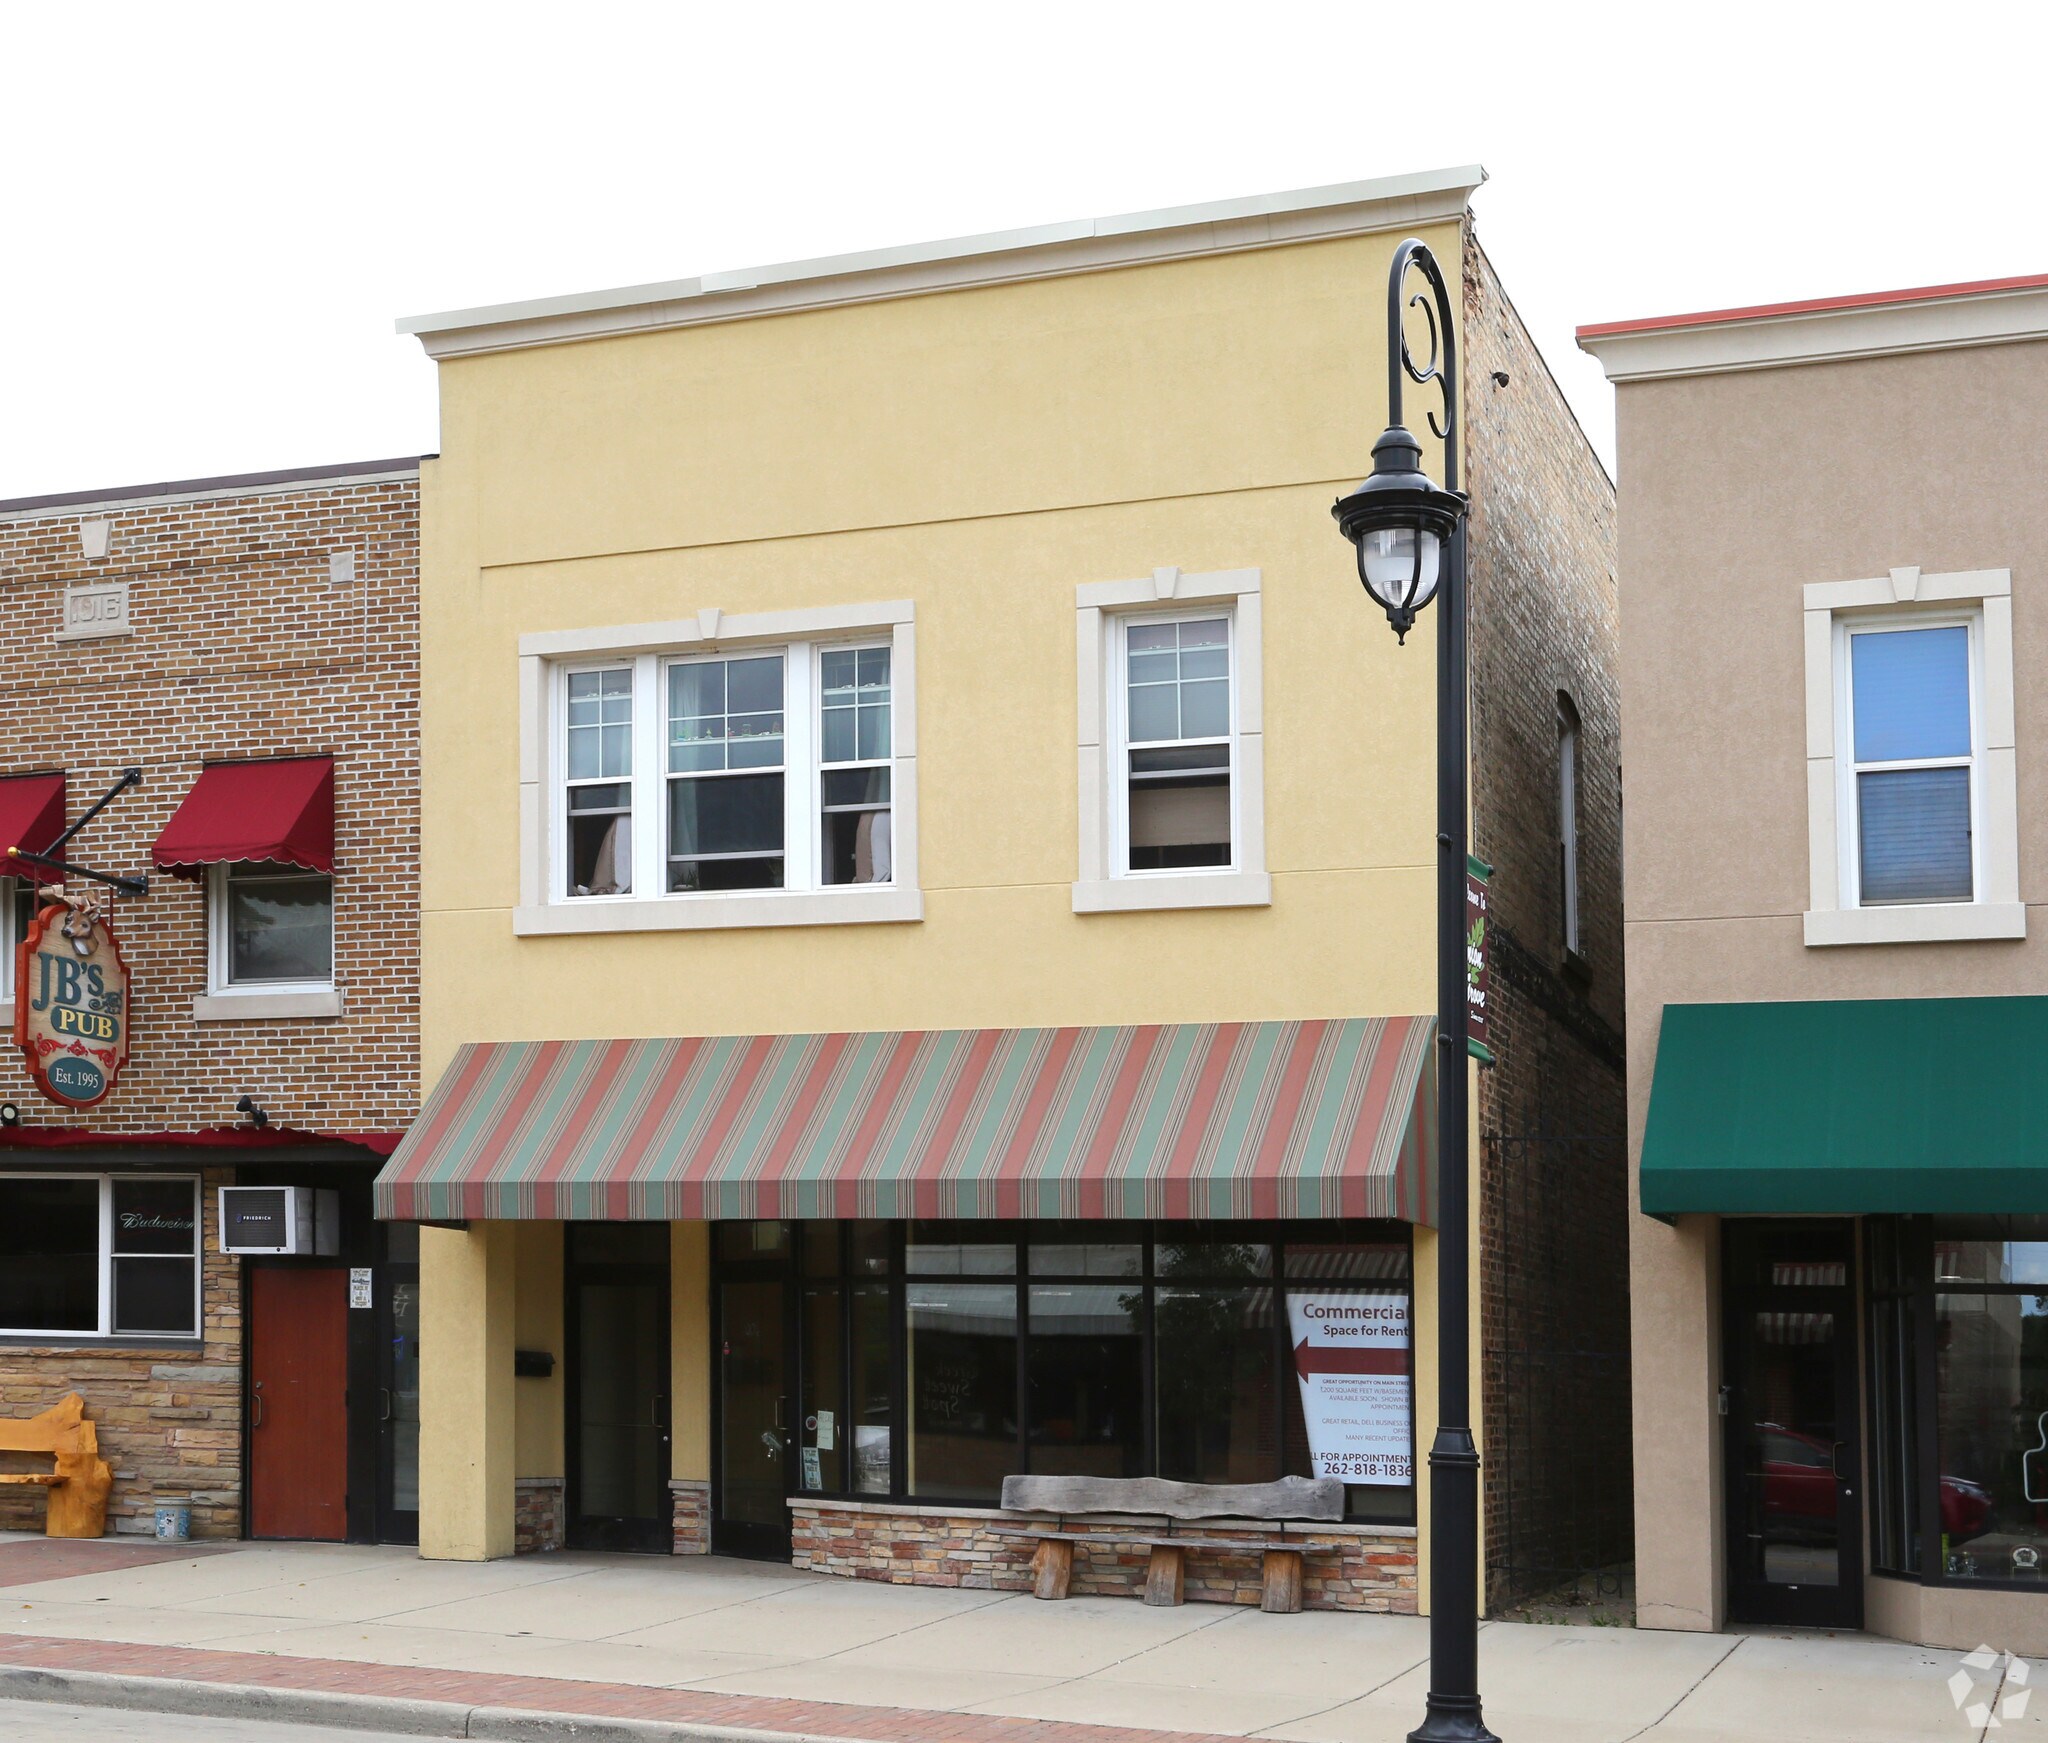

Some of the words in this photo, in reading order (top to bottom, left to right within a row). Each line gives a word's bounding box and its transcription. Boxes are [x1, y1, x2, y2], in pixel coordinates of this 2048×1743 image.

[32, 952, 104, 1011] JB's
[59, 1008, 113, 1038] PUB
[55, 1067, 74, 1084] Est.
[78, 1071, 99, 1088] 1995
[120, 1212, 195, 1229] Budweiser
[1323, 1325, 1358, 1338] Space
[1361, 1325, 1378, 1336] for
[1381, 1326, 1409, 1336] Rent
[1376, 1419, 1402, 1427] BUSINESS
[1321, 1453, 1340, 1461] FOR
[1324, 1463, 1412, 1477] 262-818-1836
